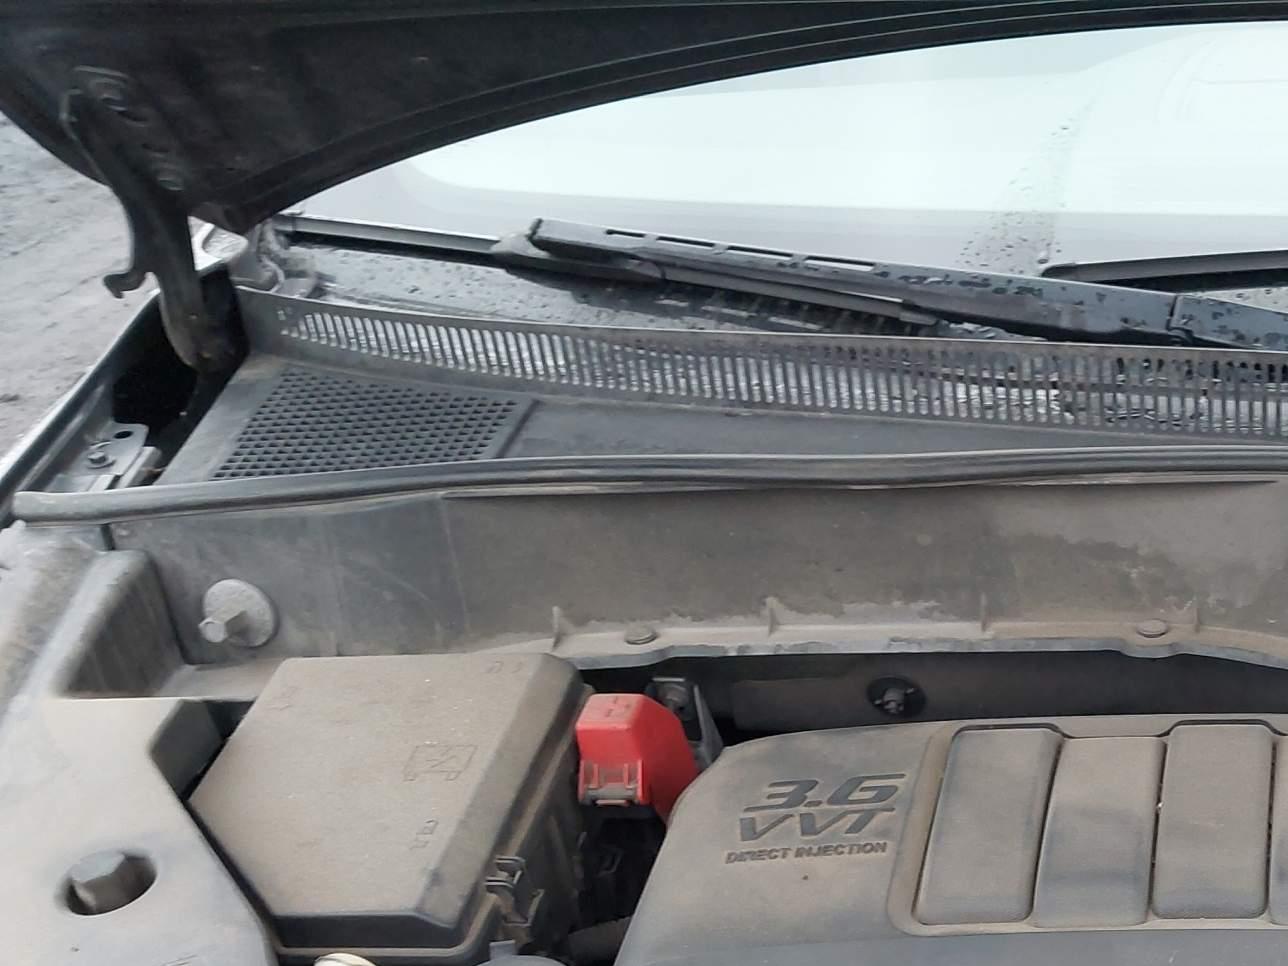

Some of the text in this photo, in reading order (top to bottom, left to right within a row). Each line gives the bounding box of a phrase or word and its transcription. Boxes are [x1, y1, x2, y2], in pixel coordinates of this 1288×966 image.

[743, 772, 907, 812] 3.6
[739, 807, 896, 842] VVT
[725, 841, 888, 864] DIRECT INJECTION
